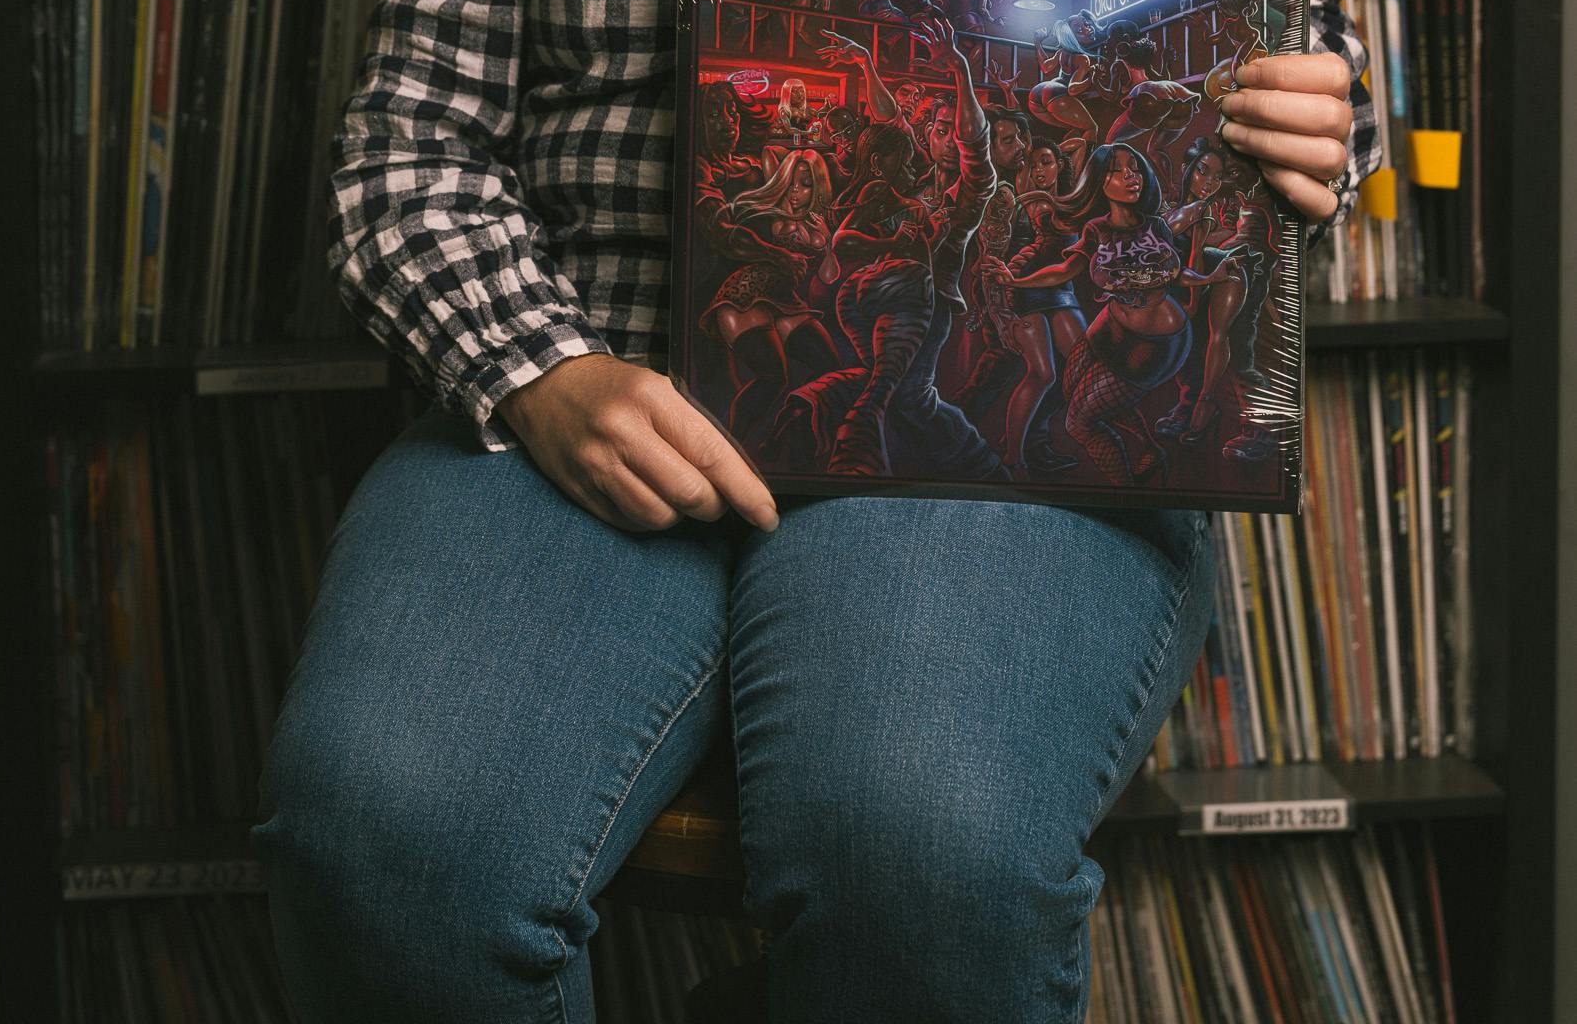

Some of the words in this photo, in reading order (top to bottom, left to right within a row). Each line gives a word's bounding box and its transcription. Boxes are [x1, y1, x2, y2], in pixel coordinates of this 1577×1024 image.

[1213, 810, 1271, 829] August
[1274, 808, 1295, 826] 31,
[1300, 807, 1341, 825] 2023
[64, 864, 133, 891] MAY
